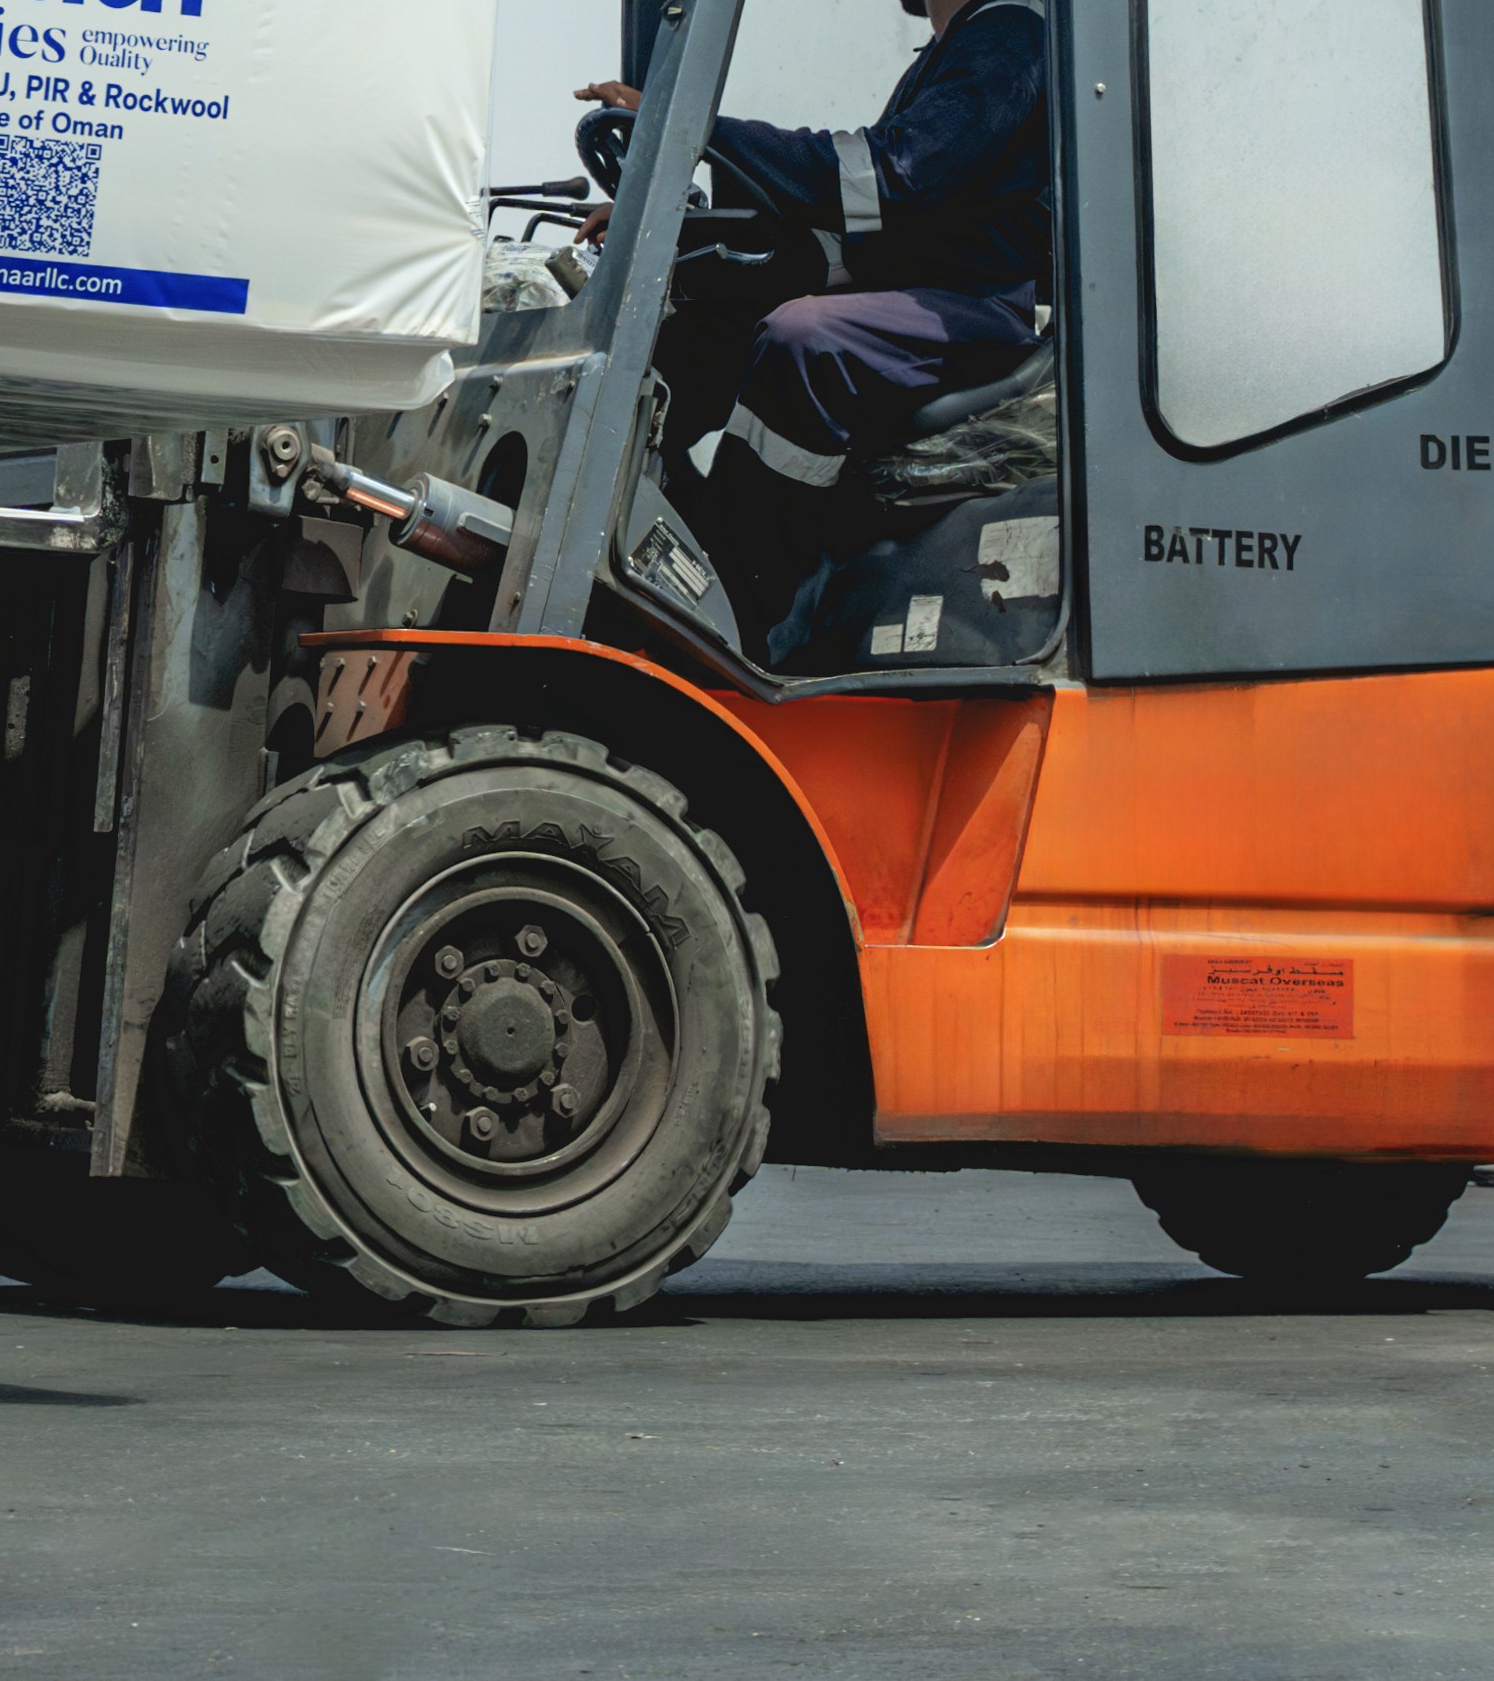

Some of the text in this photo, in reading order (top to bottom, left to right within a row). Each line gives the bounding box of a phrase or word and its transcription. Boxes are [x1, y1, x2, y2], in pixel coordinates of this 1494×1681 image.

[79, 45, 150, 76] Quality
[80, 29, 209, 61] empowering
[25, 74, 70, 103] PIR
[77, 79, 96, 106] &
[103, 82, 229, 120] Rockwool
[17, 108, 45, 131] of
[50, 111, 123, 140] Oman
[1143, 525, 1303, 571] BATTERY
[1207, 976, 1344, 987] Muscat Overseas
